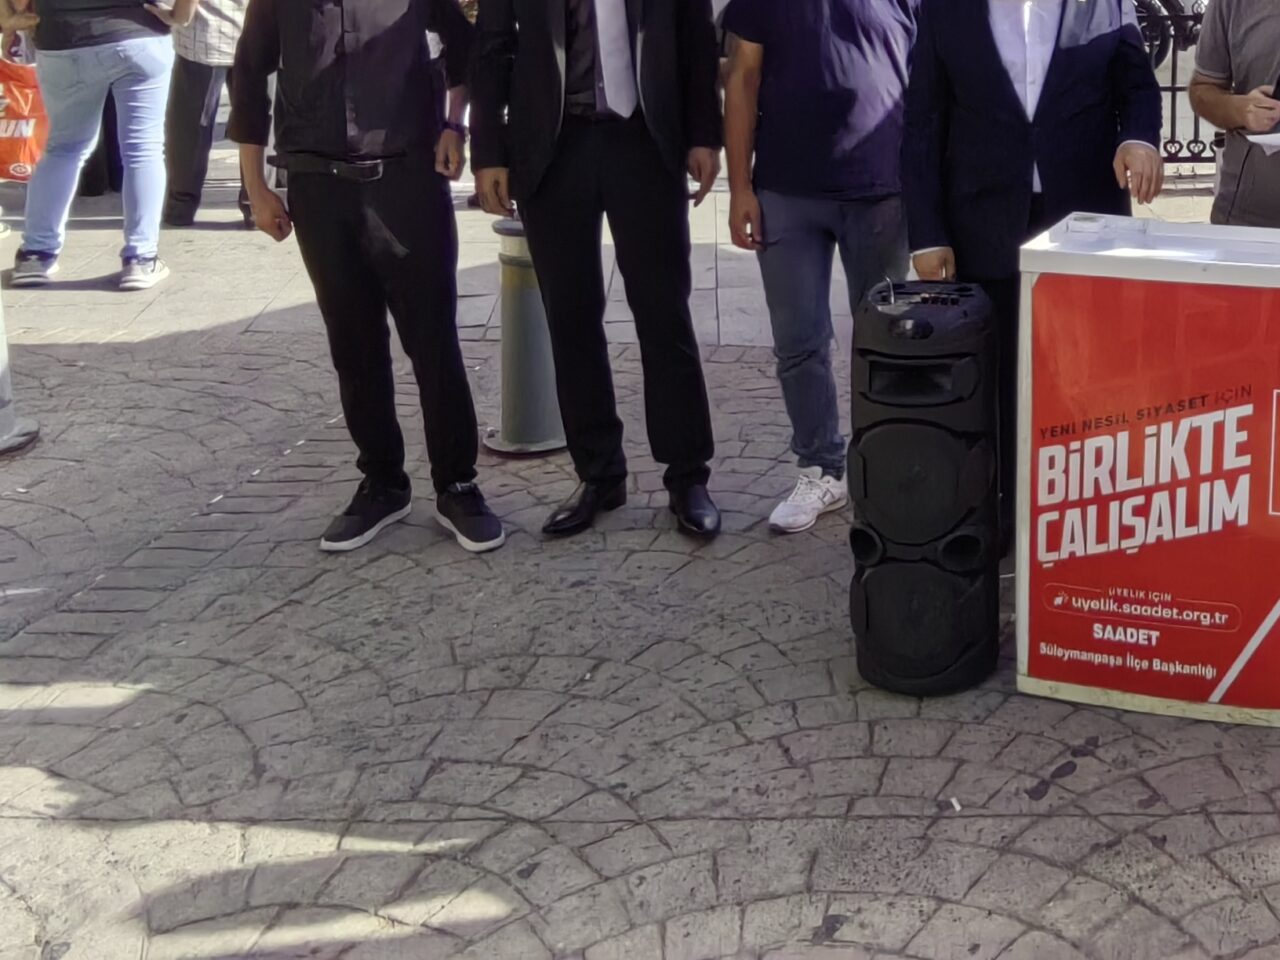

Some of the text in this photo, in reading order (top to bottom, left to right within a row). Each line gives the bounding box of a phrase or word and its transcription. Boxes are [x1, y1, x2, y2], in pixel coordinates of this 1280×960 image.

[1136, 394, 1210, 422] SİYASET
[1037, 403, 1254, 507] BİRLİKTE
[1037, 473, 1251, 569] ÇALIŞALIM
[1071, 596, 1229, 626] uyelik.saadet.org.tr
[1092, 622, 1161, 647] SAADET
[1039, 641, 1217, 679] Süleymanpaşa İlçe Başkanlığı
